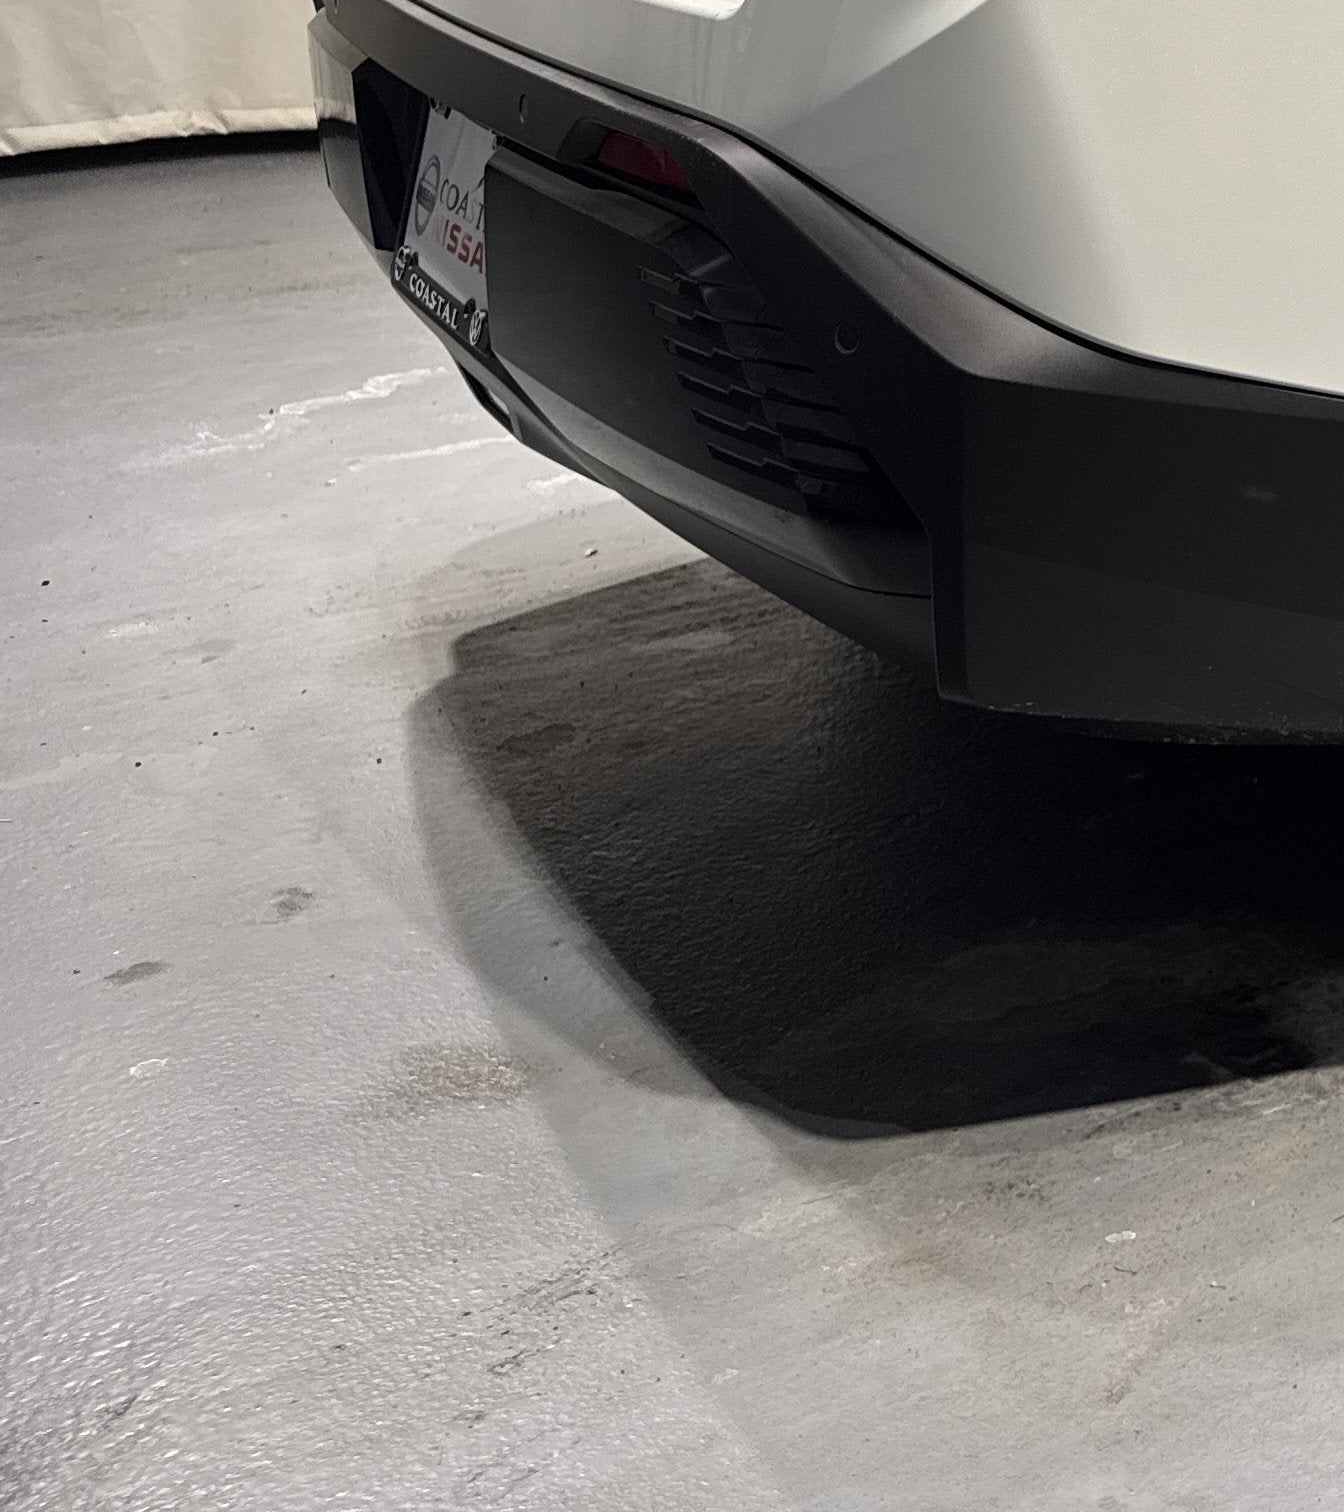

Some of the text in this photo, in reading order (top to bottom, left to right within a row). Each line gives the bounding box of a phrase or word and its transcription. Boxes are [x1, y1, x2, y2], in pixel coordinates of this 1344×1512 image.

[440, 178, 485, 232] COAST
[432, 214, 486, 276] NISSA
[410, 273, 458, 330] COASTAL
